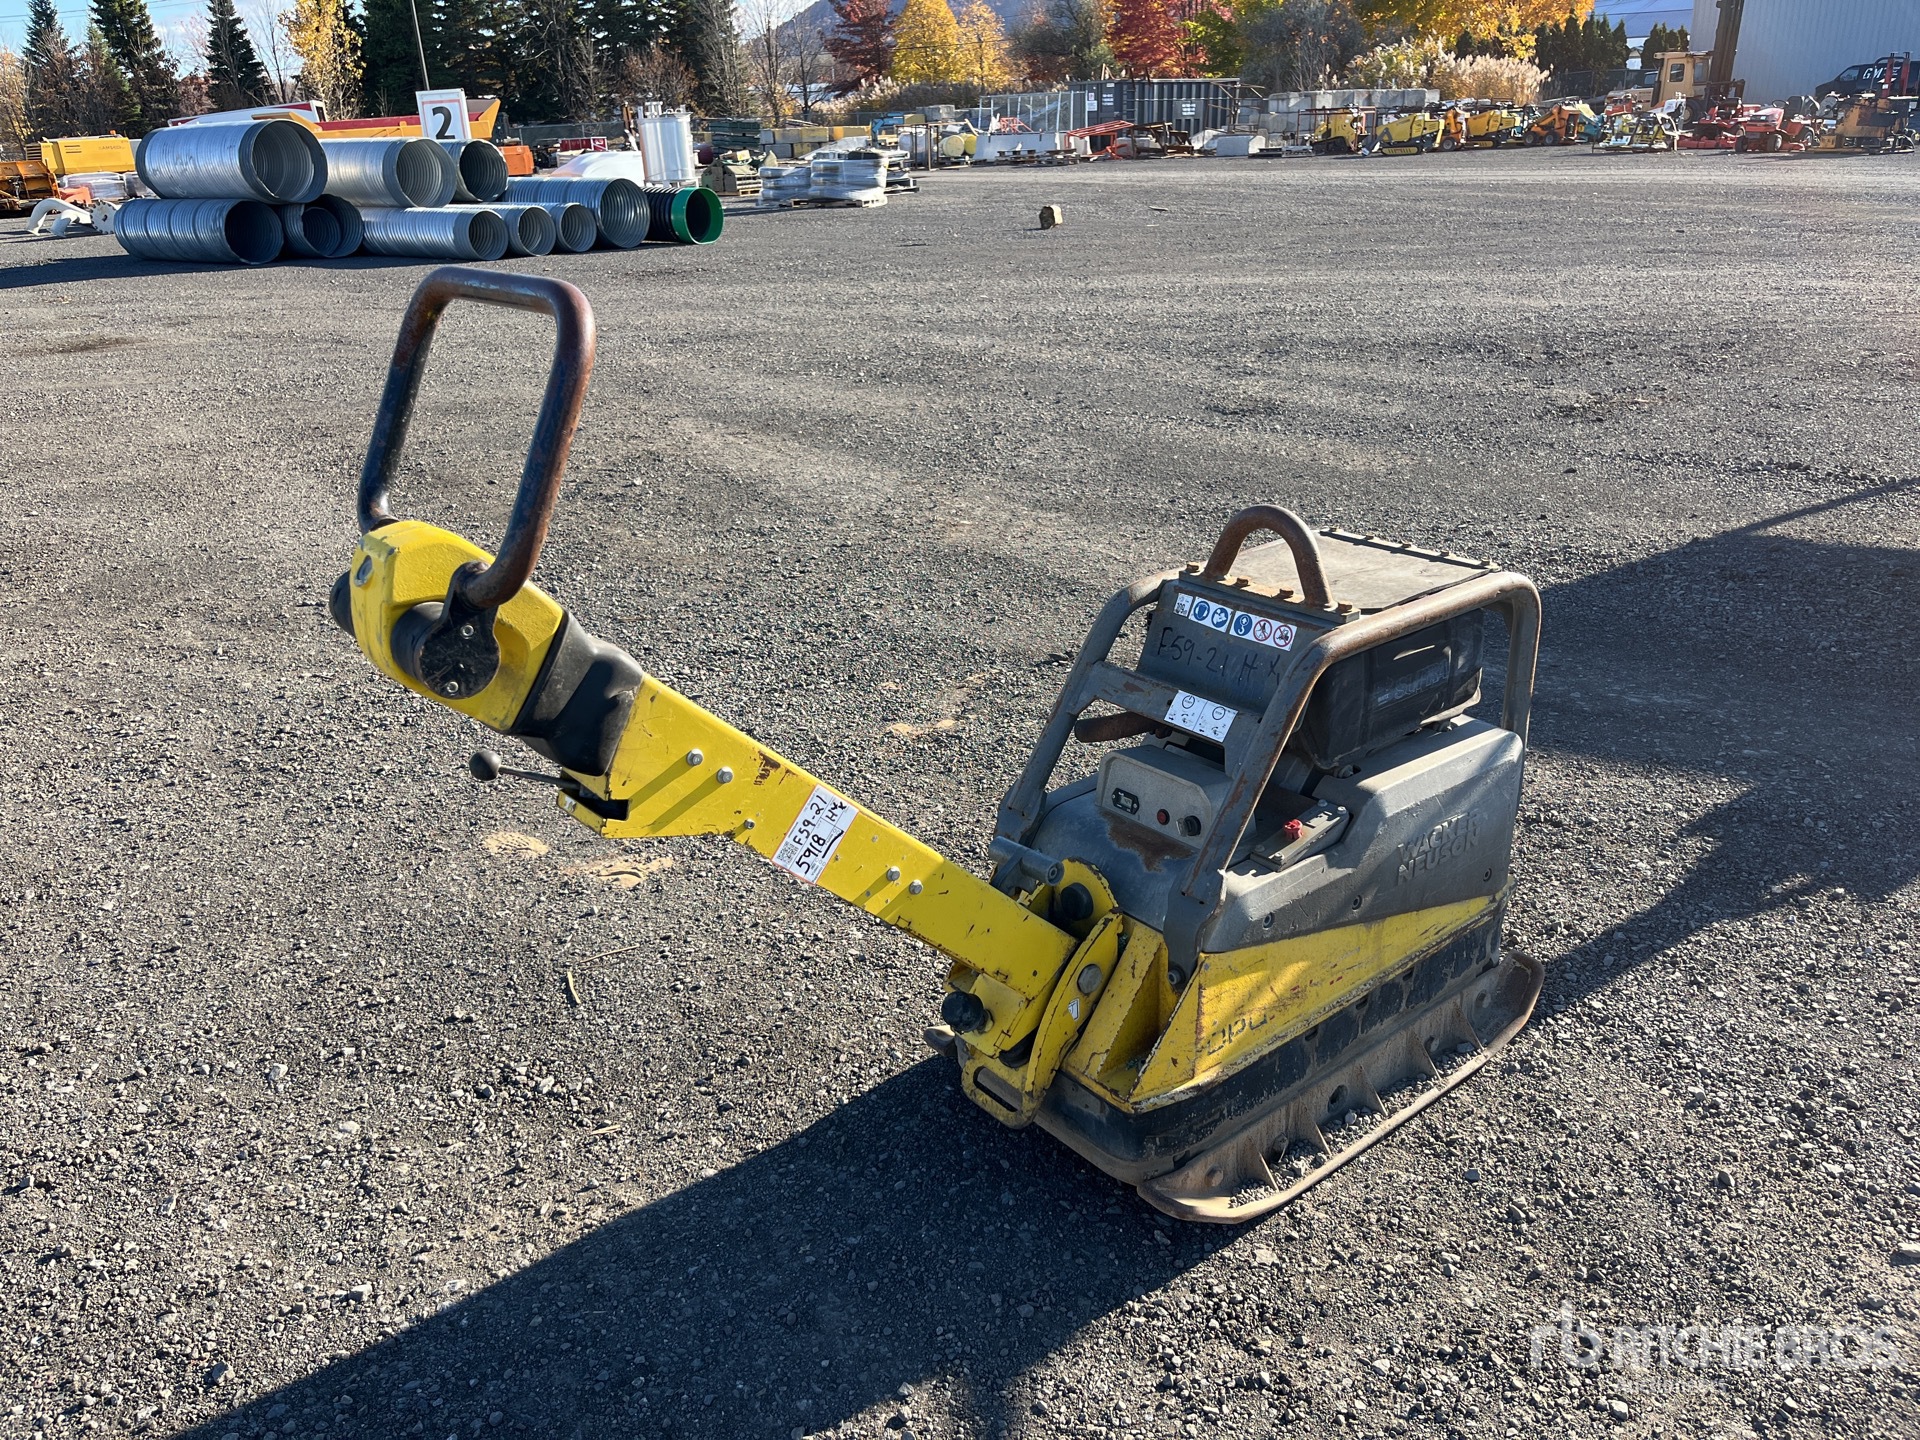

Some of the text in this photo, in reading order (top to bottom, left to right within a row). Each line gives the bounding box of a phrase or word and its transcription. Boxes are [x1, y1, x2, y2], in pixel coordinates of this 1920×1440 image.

[432, 106, 456, 140] 2
[1158, 627, 1229, 677] F59-21
[793, 795, 828, 846] F59-21
[1398, 809, 1479, 860] WACKER
[796, 834, 826, 875] 5918
[1397, 828, 1479, 886] NEUSON
